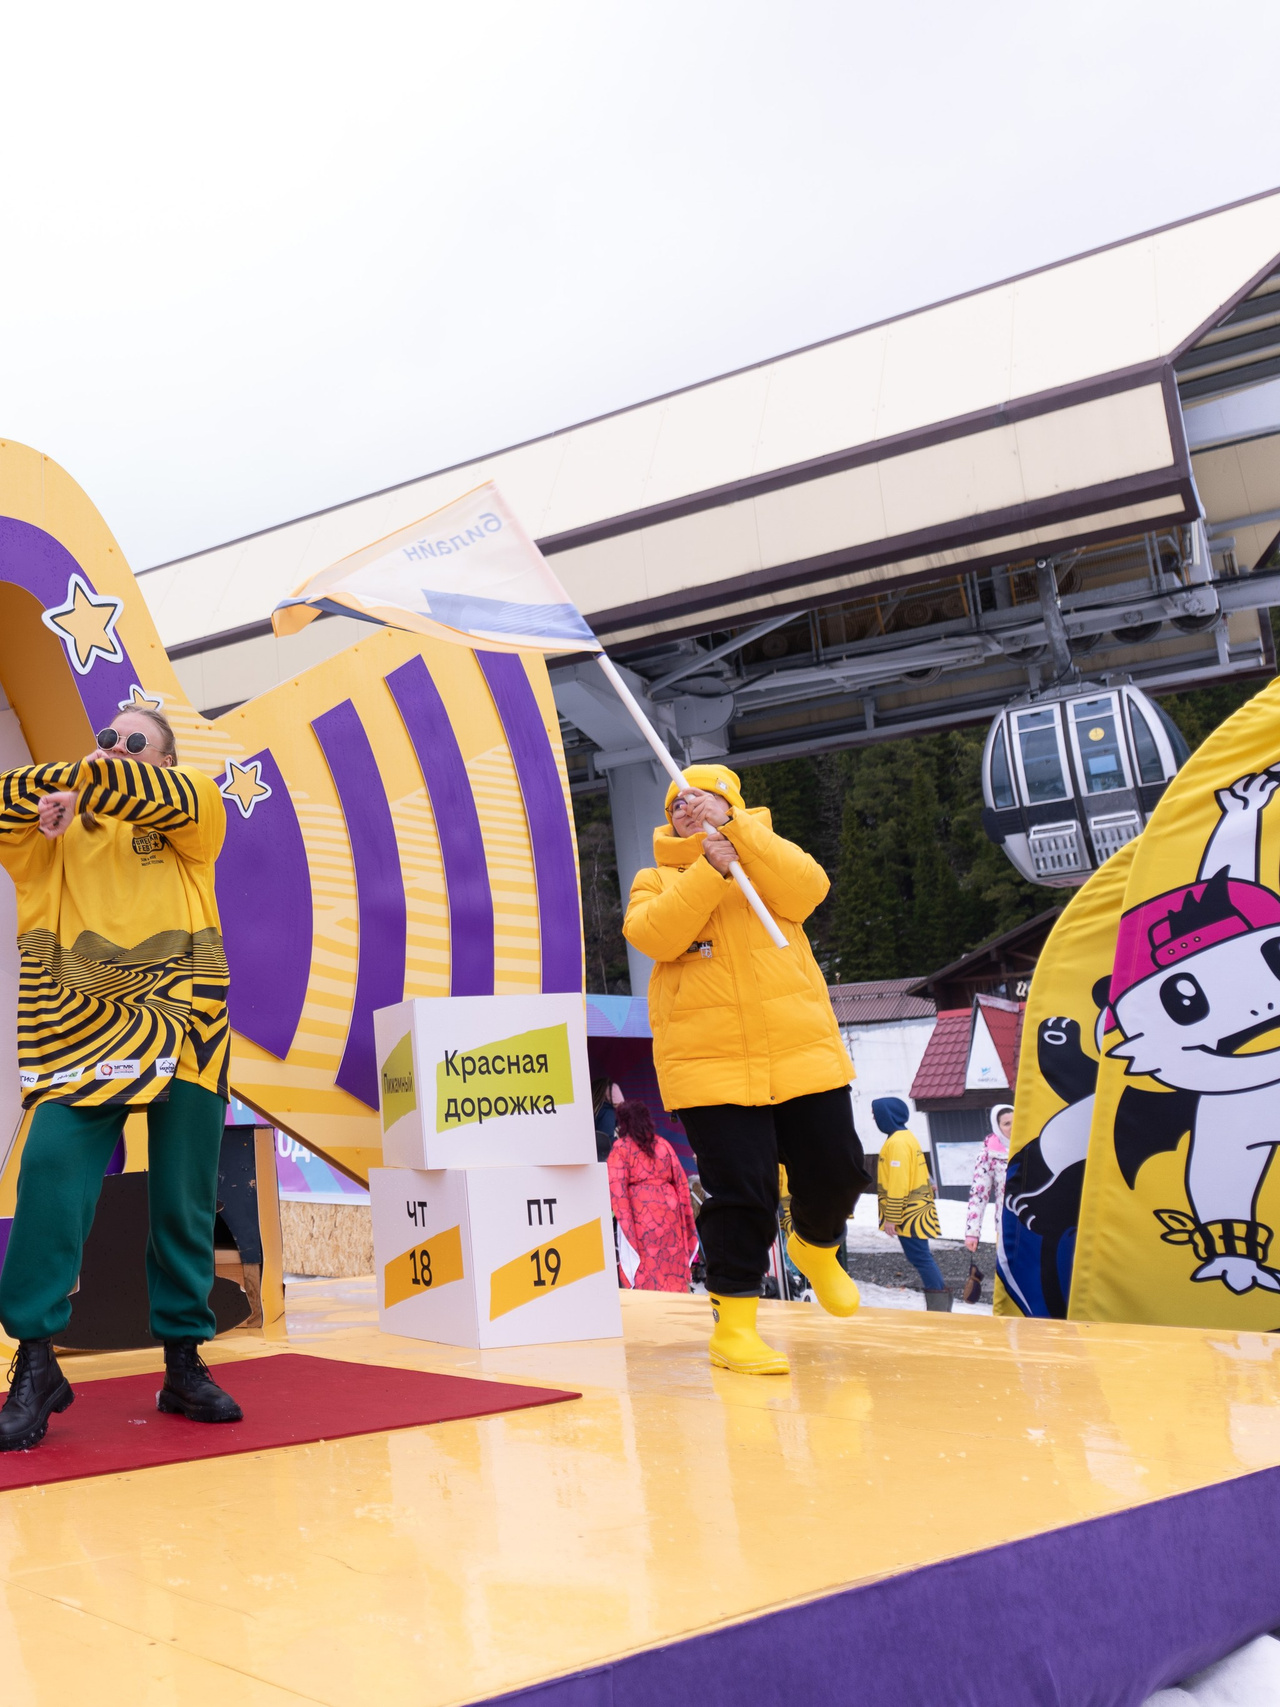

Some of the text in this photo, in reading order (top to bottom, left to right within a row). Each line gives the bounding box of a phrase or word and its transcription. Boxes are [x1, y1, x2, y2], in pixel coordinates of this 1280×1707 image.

[444, 1050, 549, 1083] Красная
[444, 1094, 557, 1124] дорожка
[409, 1249, 433, 1287] 18
[530, 1247, 561, 1287] 19
